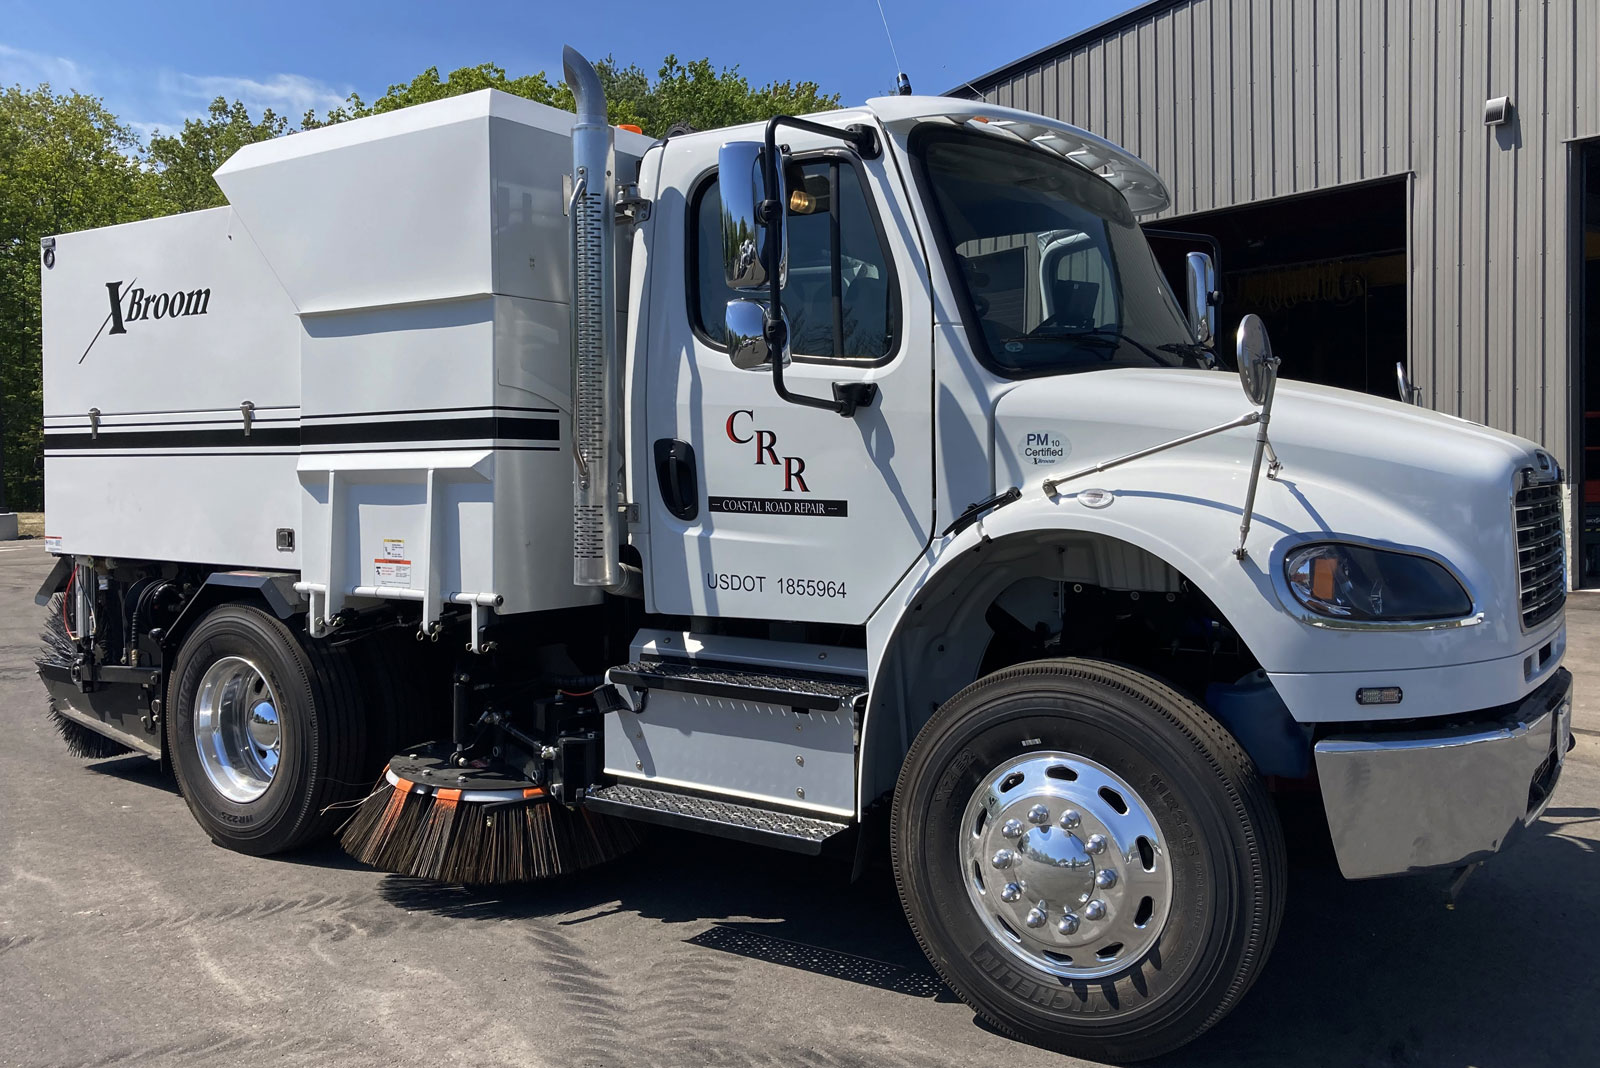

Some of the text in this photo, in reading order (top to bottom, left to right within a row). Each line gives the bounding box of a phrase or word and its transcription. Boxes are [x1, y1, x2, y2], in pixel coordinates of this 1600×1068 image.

[79, 277, 211, 364] XBroom
[1027, 433, 1048, 446] PM
[1025, 448, 1063, 456] Certified
[722, 499, 825, 514] COASTAL ROAD REPAIR
[707, 573, 847, 598] USDOT 1855964
[973, 948, 1110, 1013] MICHELIN
